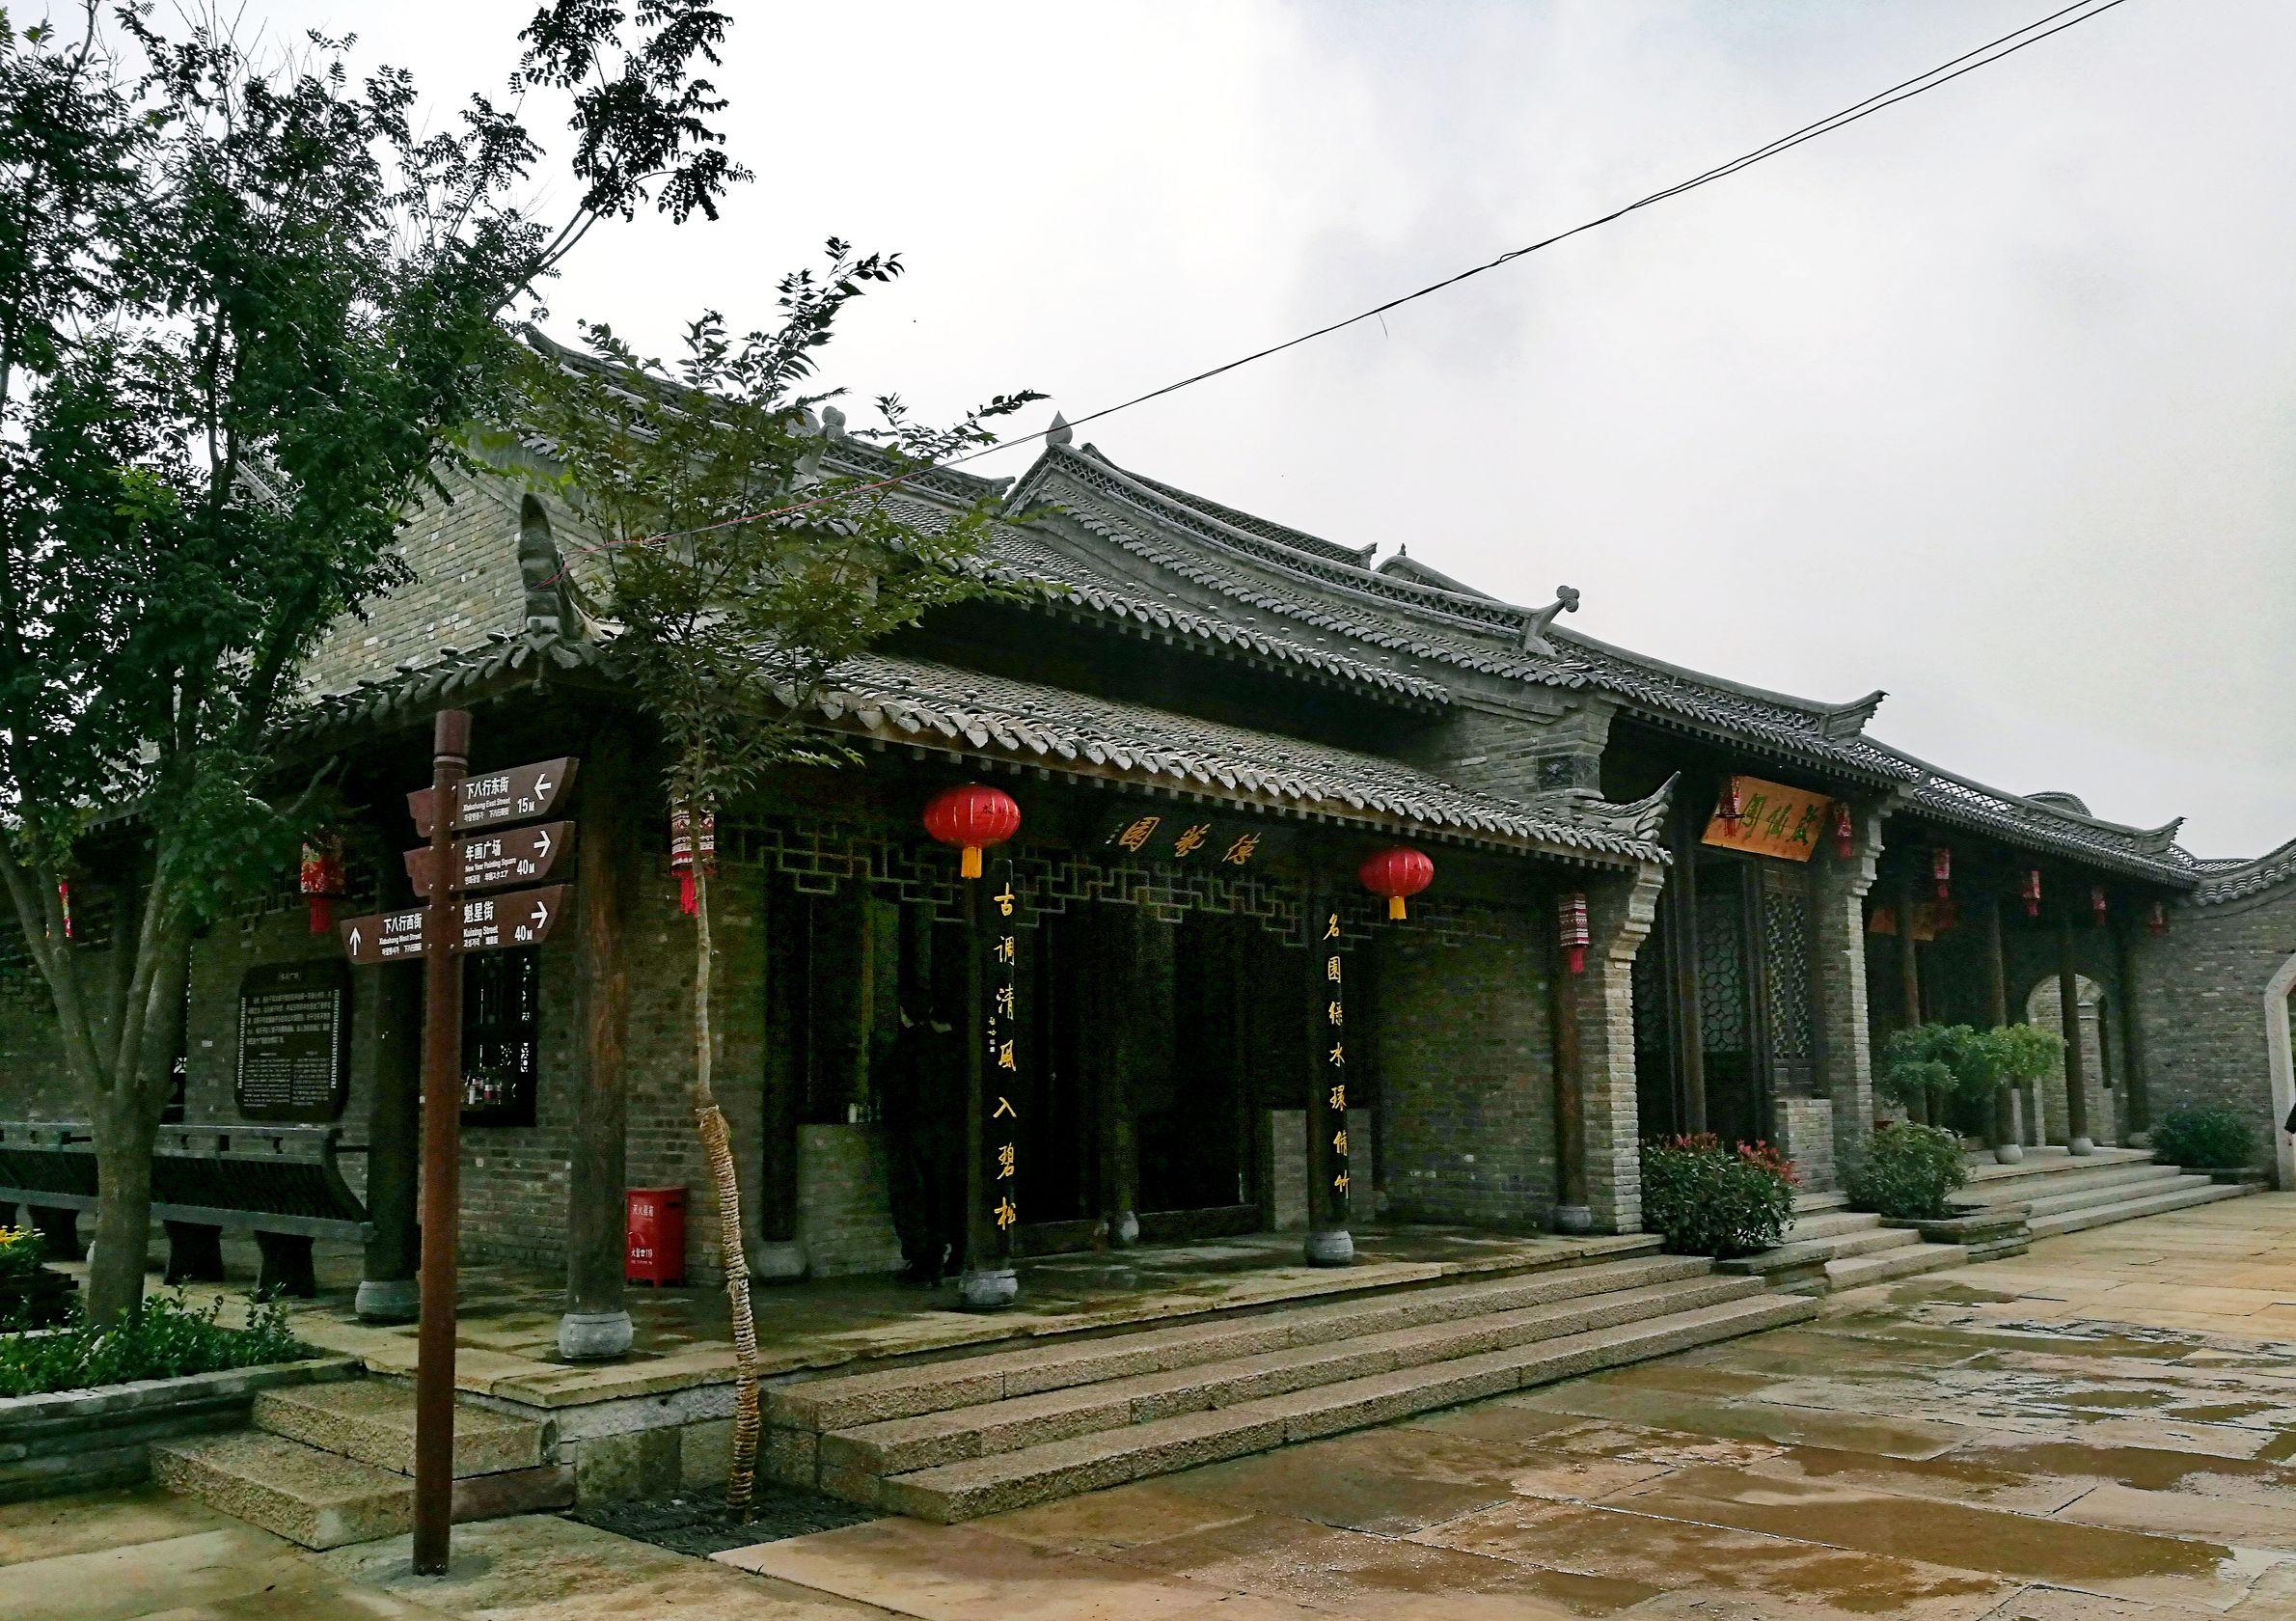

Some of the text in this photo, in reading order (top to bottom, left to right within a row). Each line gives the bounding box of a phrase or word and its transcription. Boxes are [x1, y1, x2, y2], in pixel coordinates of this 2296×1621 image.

[465, 777, 509, 799] 下八行东街
[496, 797, 510, 807] Street
[465, 839, 502, 862] 年画广场
[463, 901, 494, 923] 魁星街
[384, 913, 423, 934] 下八行西街
[482, 924, 499, 936] Street
